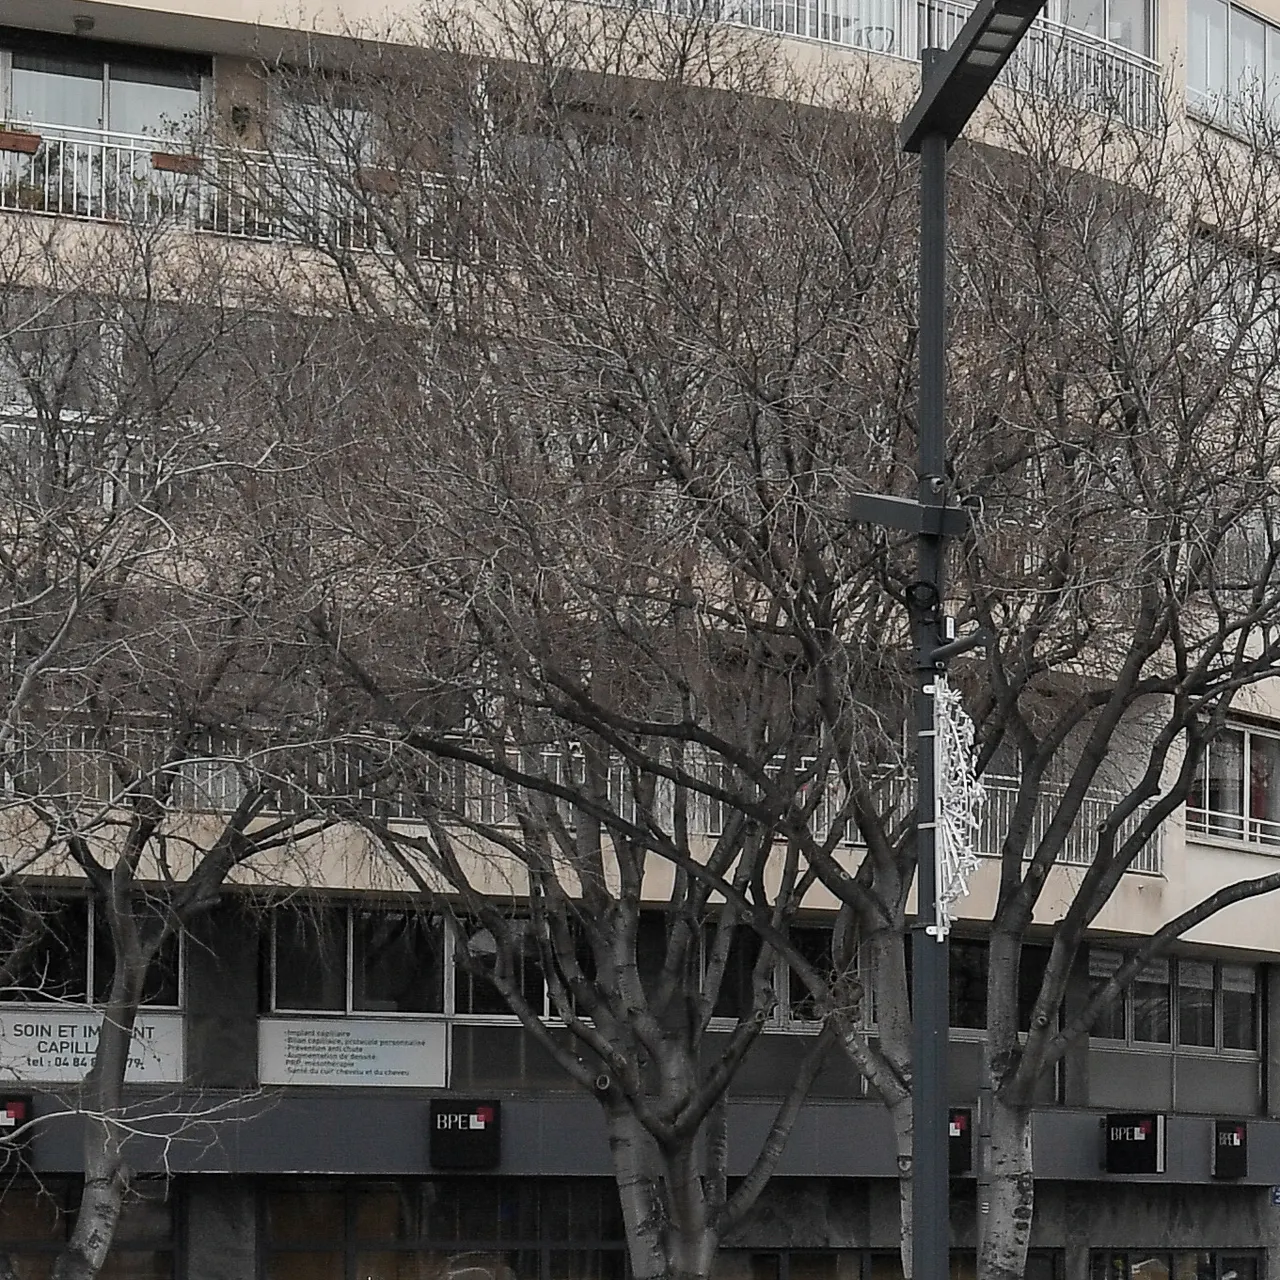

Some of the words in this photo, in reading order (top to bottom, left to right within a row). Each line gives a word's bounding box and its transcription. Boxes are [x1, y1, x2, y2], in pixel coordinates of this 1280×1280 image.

[13, 1024, 52, 1037] SOIN
[58, 1025, 78, 1038] ET
[83, 1026, 155, 1039] IMNT
[27, 1058, 44, 1067] tel
[55, 1058, 69, 1067] 04
[73, 1058, 87, 1067] 84
[437, 1113, 468, 1130] BPE
[1111, 1126, 1134, 1141] BPE
